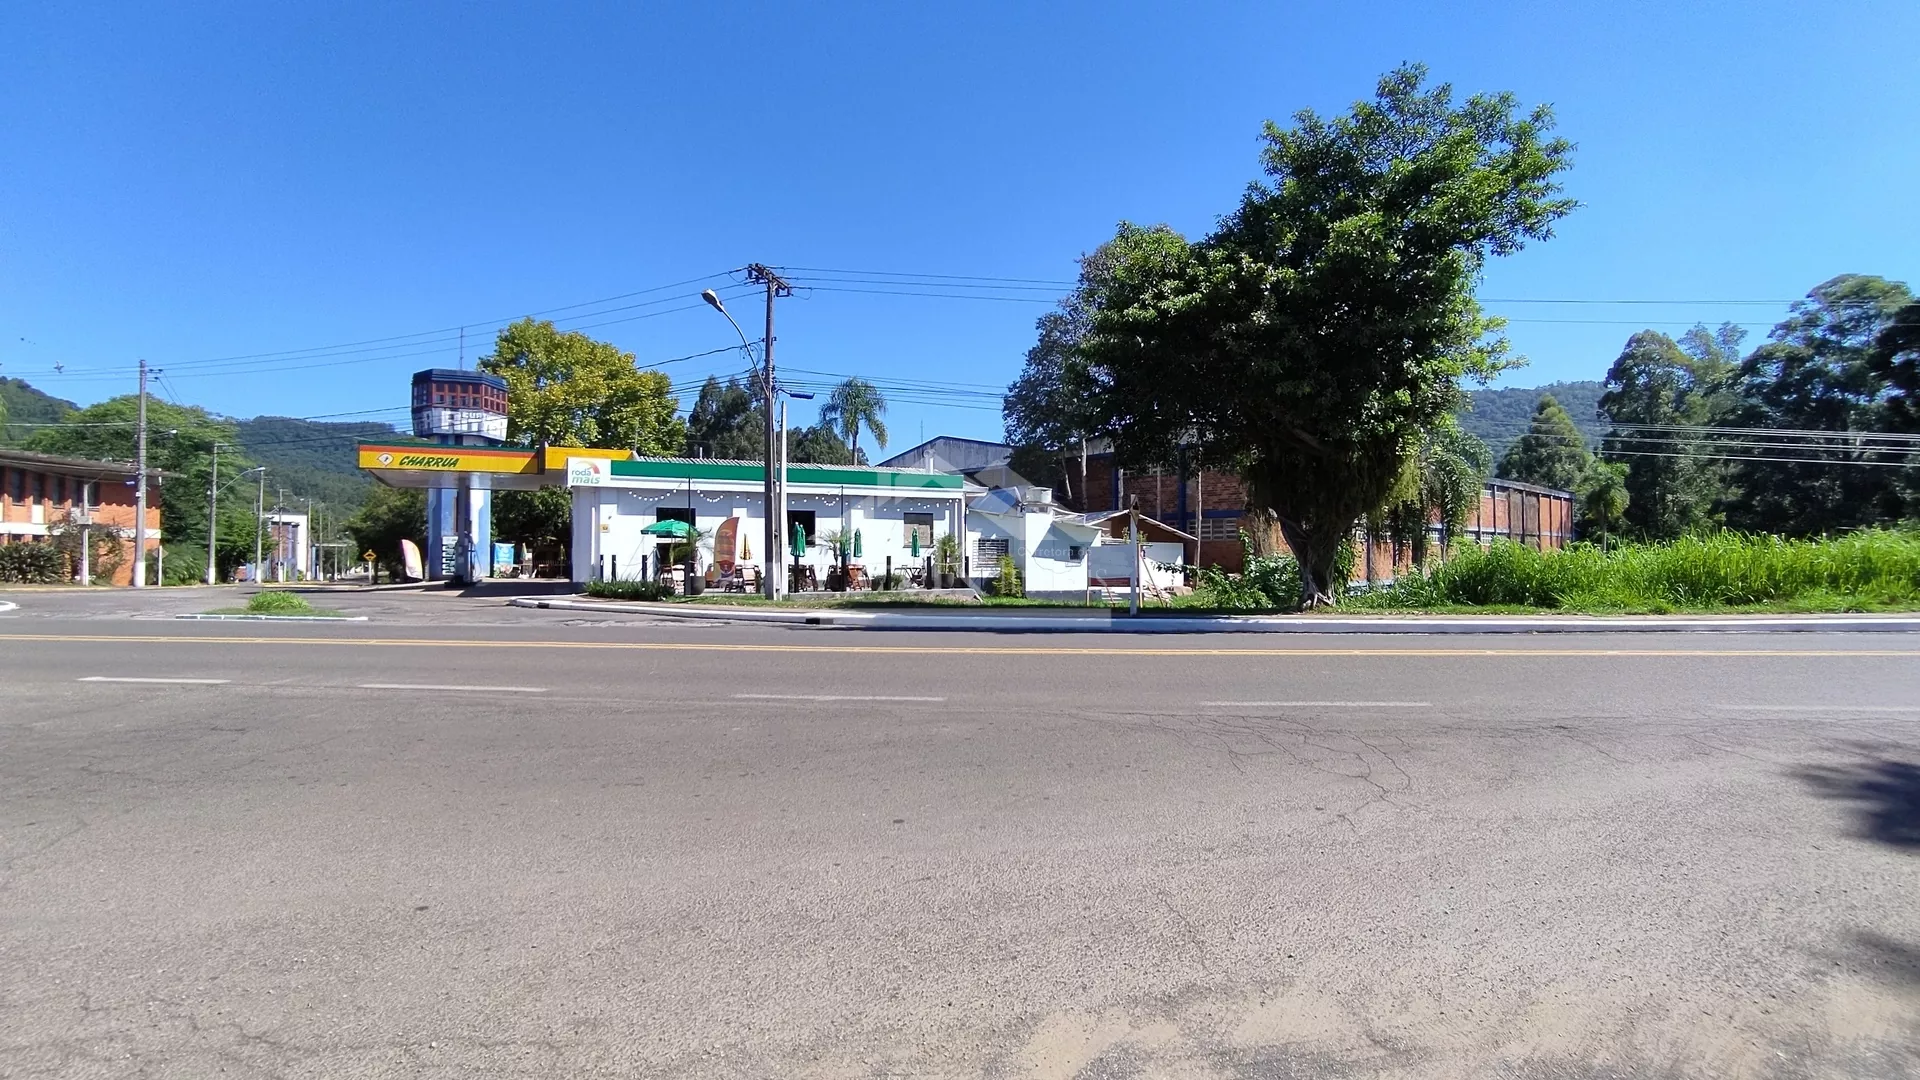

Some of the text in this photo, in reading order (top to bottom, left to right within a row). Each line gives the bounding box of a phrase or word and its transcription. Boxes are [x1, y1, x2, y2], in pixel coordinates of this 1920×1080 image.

[399, 455, 460, 468] CHARRUA
[571, 467, 592, 476] roda
[571, 476, 601, 485] mais
